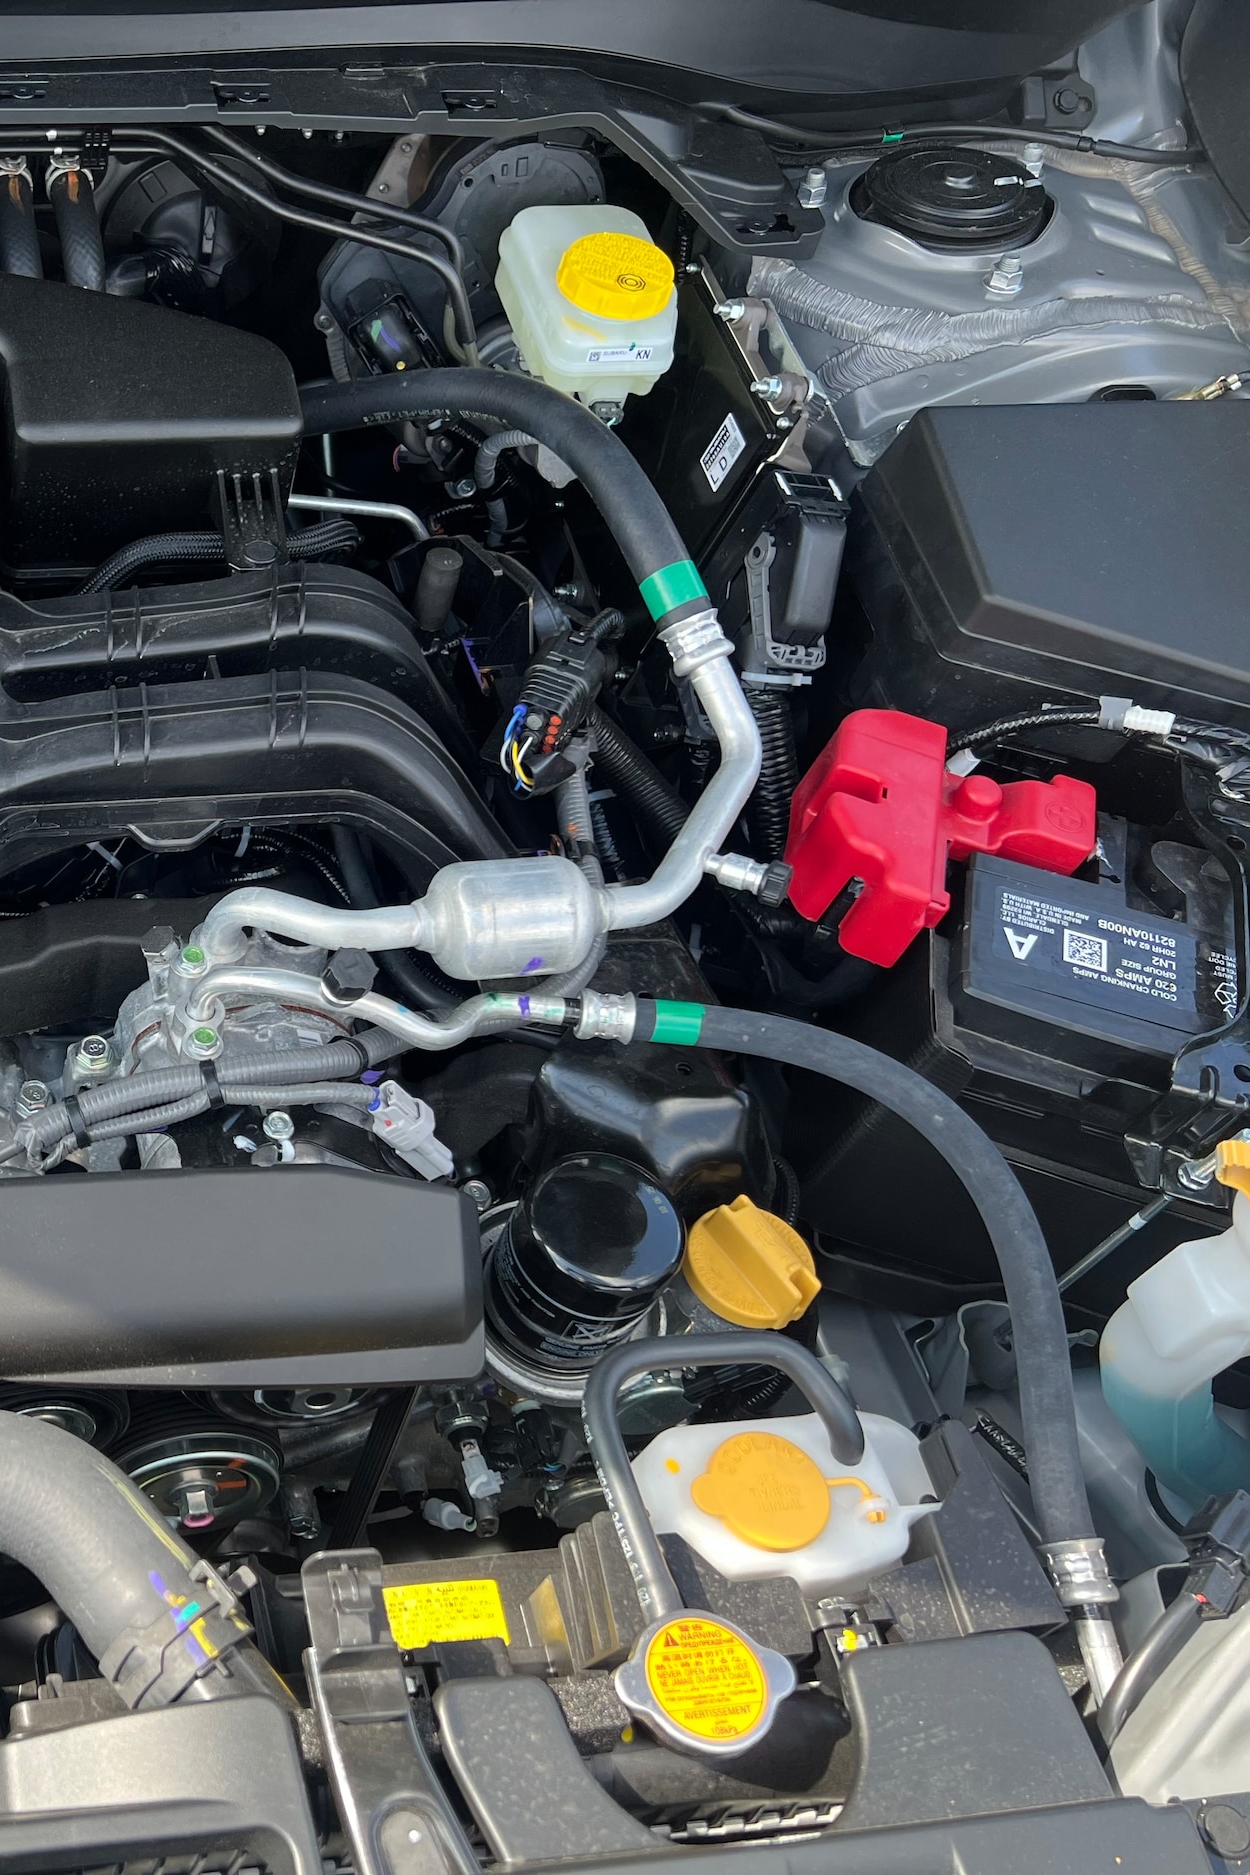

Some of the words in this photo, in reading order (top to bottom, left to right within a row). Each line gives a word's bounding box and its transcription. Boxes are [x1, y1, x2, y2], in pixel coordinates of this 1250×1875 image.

[635, 349, 651, 360] KN
[1003, 892, 1041, 908] MATERIALS
[1015, 901, 1033, 911] WITH
[1041, 903, 1075, 917] IMPORTED
[1076, 912, 1090, 921] AND
[1012, 917, 1055, 935] DISTRIBUTED
[1063, 915, 1082, 925] MADE
[1097, 919, 1176, 948] 82110AN00B
[1003, 926, 1039, 960] A
[1123, 937, 1137, 947] AH
[1139, 941, 1150, 951] 62
[1152, 945, 1177, 957] 20HR
[1121, 958, 1142, 970] SIZE
[1151, 956, 1176, 971] LN2
[1072, 966, 1100, 980] AMPS
[1115, 968, 1152, 986] AMPS
[1143, 966, 1177, 980] GROUP
[1100, 974, 1150, 994] CRANKING
[1154, 979, 1178, 993] 620
[1150, 988, 1178, 1002] COLD
[678, 1630, 722, 1641] WARNING
[657, 1668, 682, 1680] NEVER
[685, 1667, 705, 1677] OPEN
[709, 1664, 730, 1674] WHEN
[733, 1662, 749, 1671] HOT
[684, 1704, 751, 1720] AVERTISSEMENT
